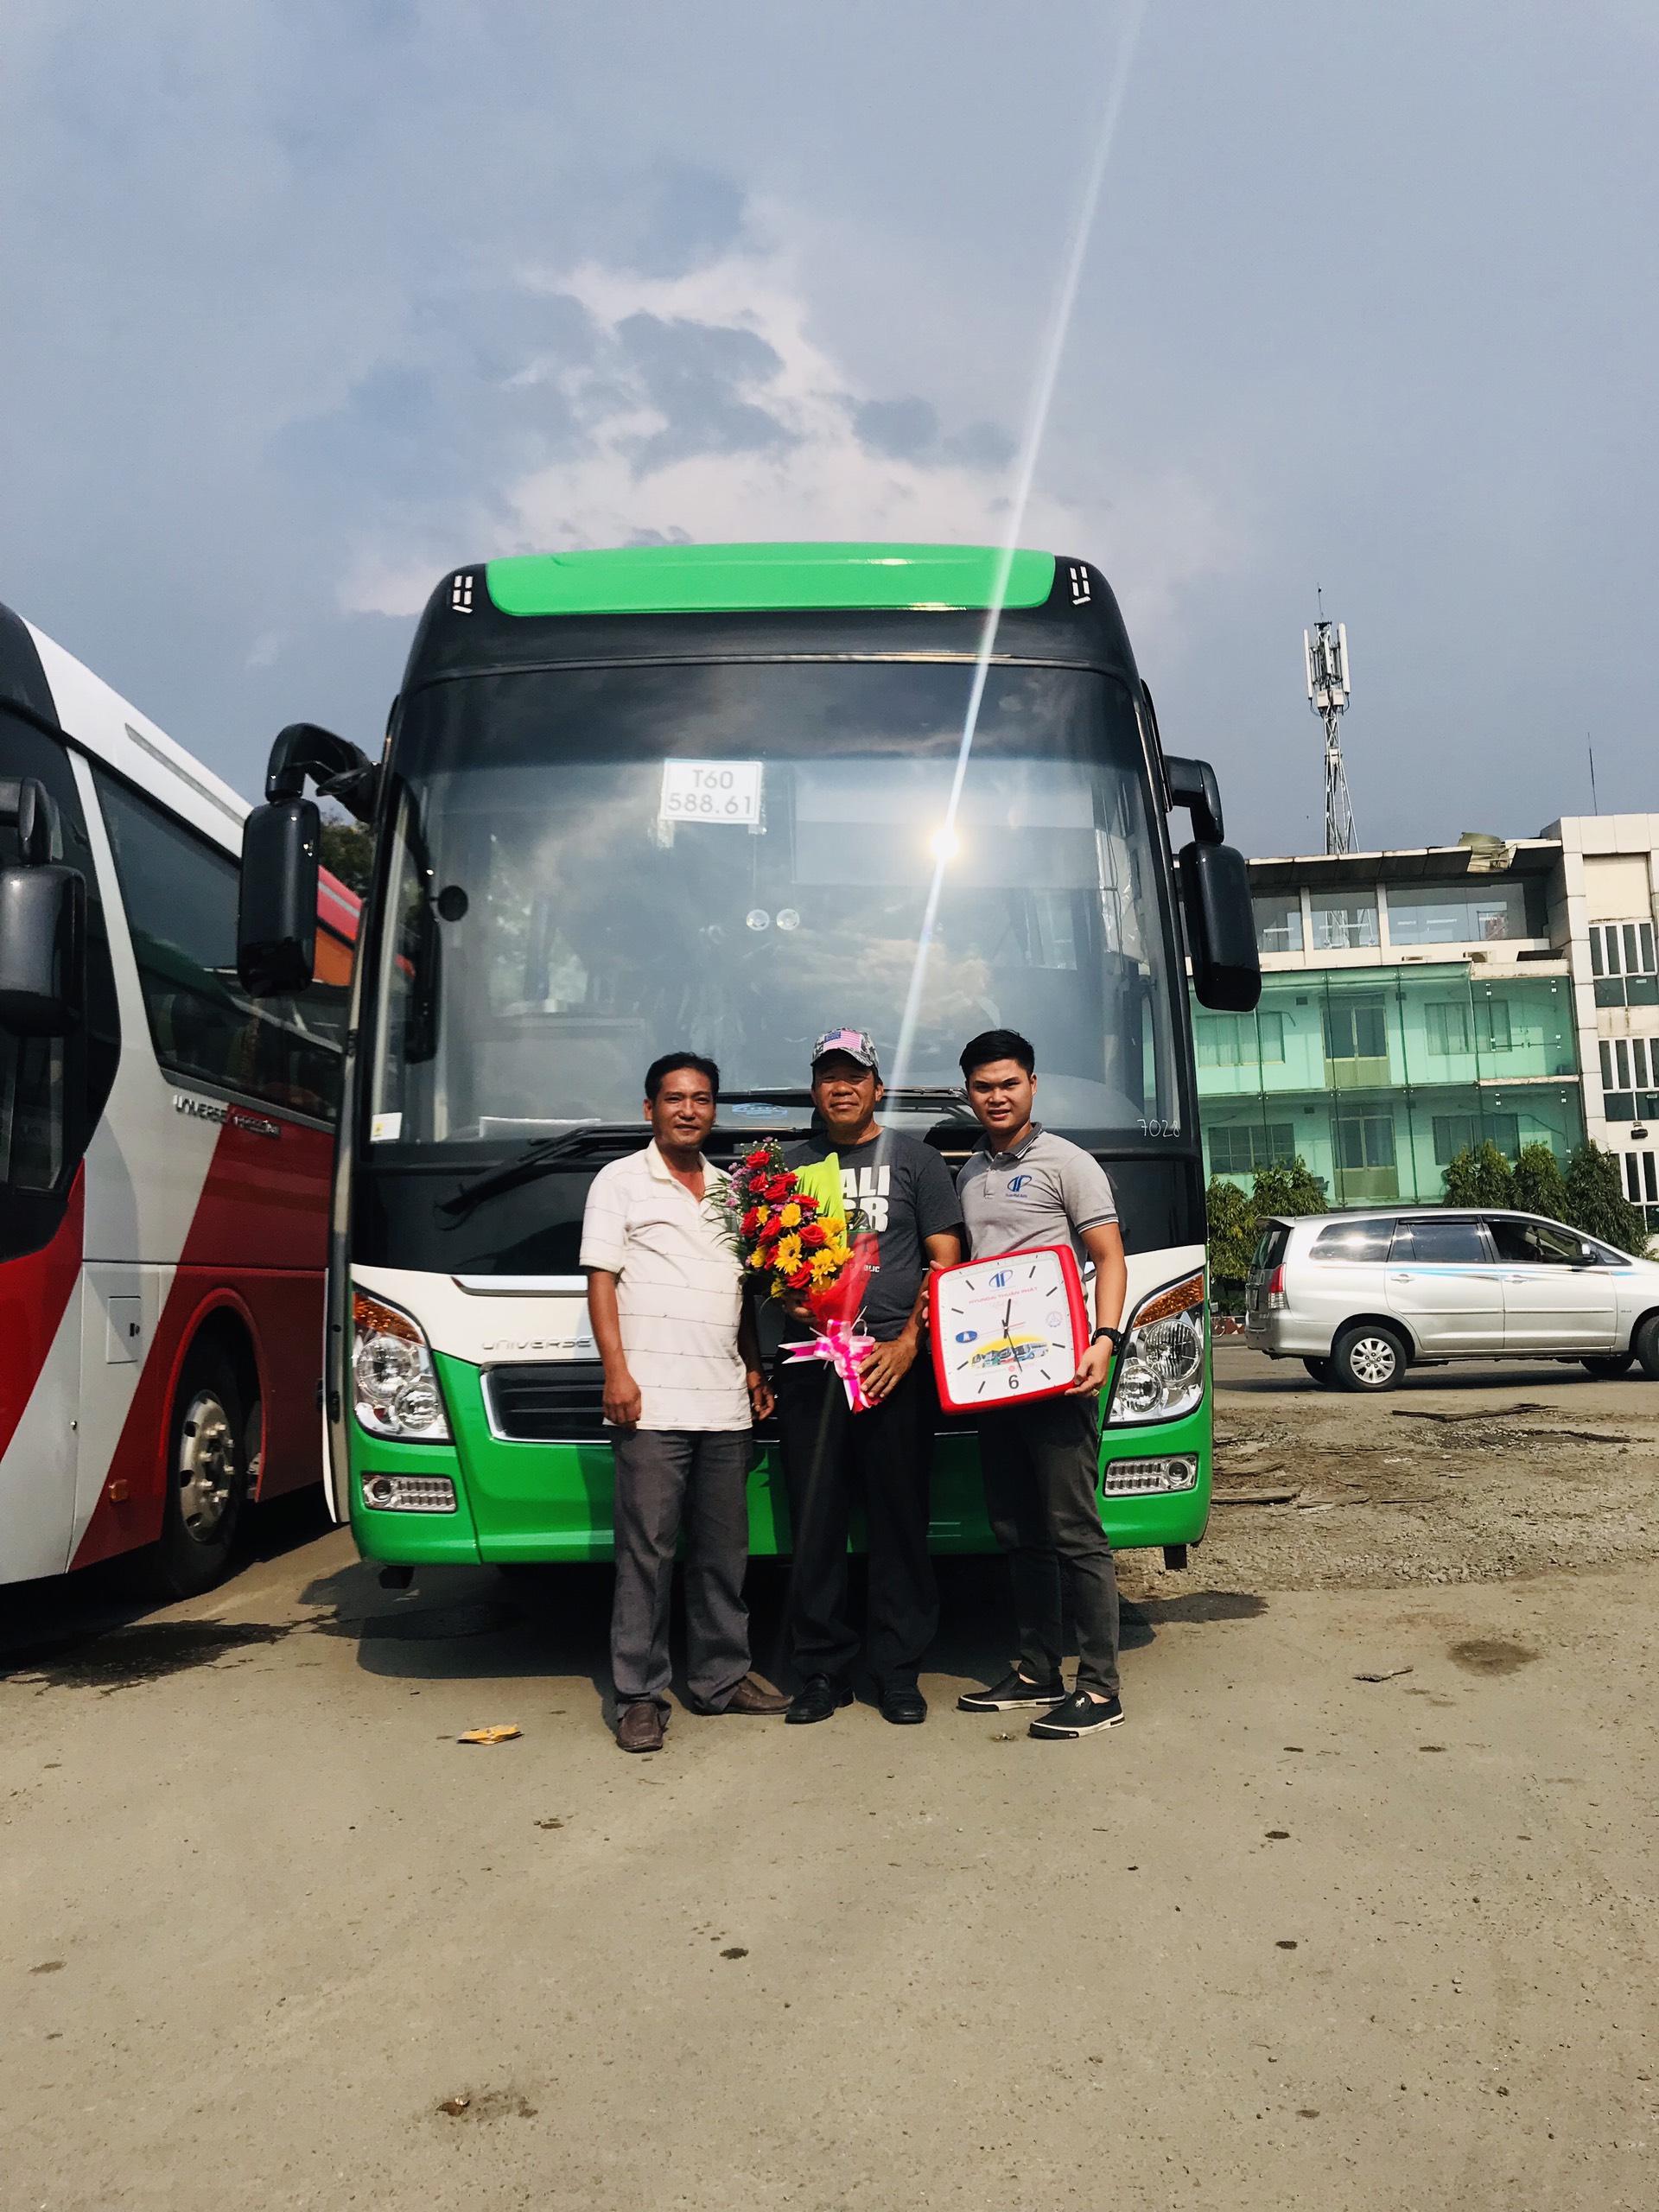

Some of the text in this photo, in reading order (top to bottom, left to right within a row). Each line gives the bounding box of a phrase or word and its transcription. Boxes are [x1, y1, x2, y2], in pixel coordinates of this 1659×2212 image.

[692, 769, 734, 790] T60
[667, 793, 751, 815] 588.61
[1136, 1119, 1180, 1137] 7028
[482, 1336, 594, 1351] UNIVERSE
[1008, 1374, 1020, 1389] 6
